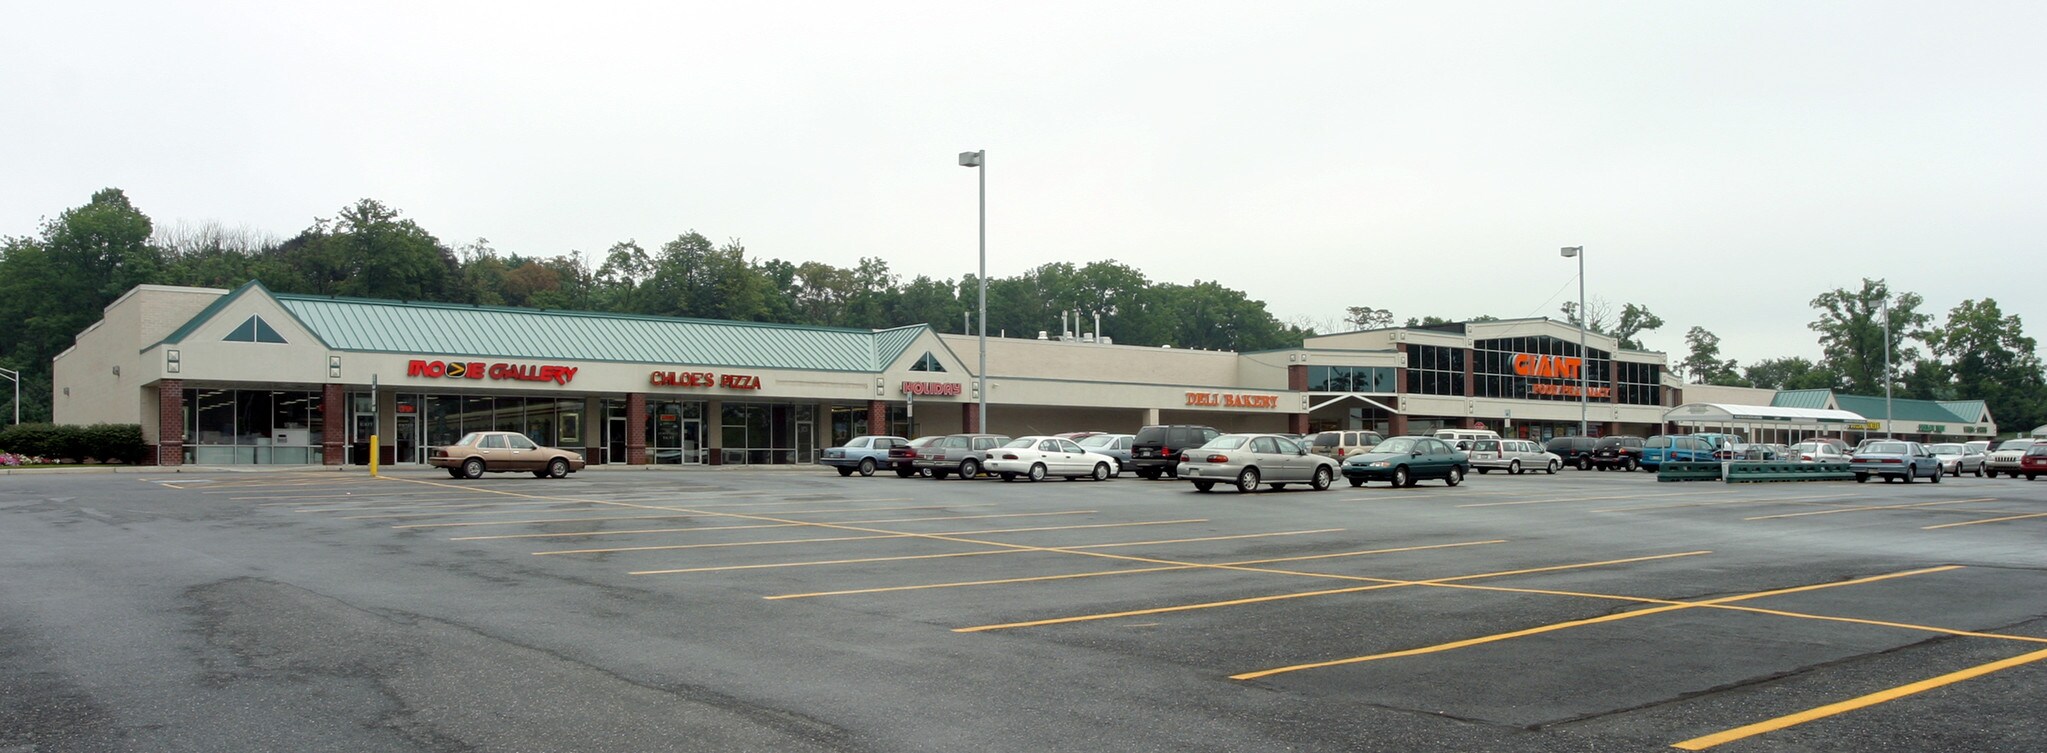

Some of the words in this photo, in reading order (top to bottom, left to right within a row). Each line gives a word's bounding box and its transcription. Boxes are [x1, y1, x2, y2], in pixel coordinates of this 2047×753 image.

[488, 363, 579, 385] GALLERY
[1512, 353, 1582, 379] GIANT
[651, 371, 715, 388] CHLOE'S
[720, 374, 761, 390] PIZZA
[902, 381, 962, 396] HOLIDAY
[1185, 392, 1219, 407] DELI
[1223, 393, 1279, 409] BAKERY
